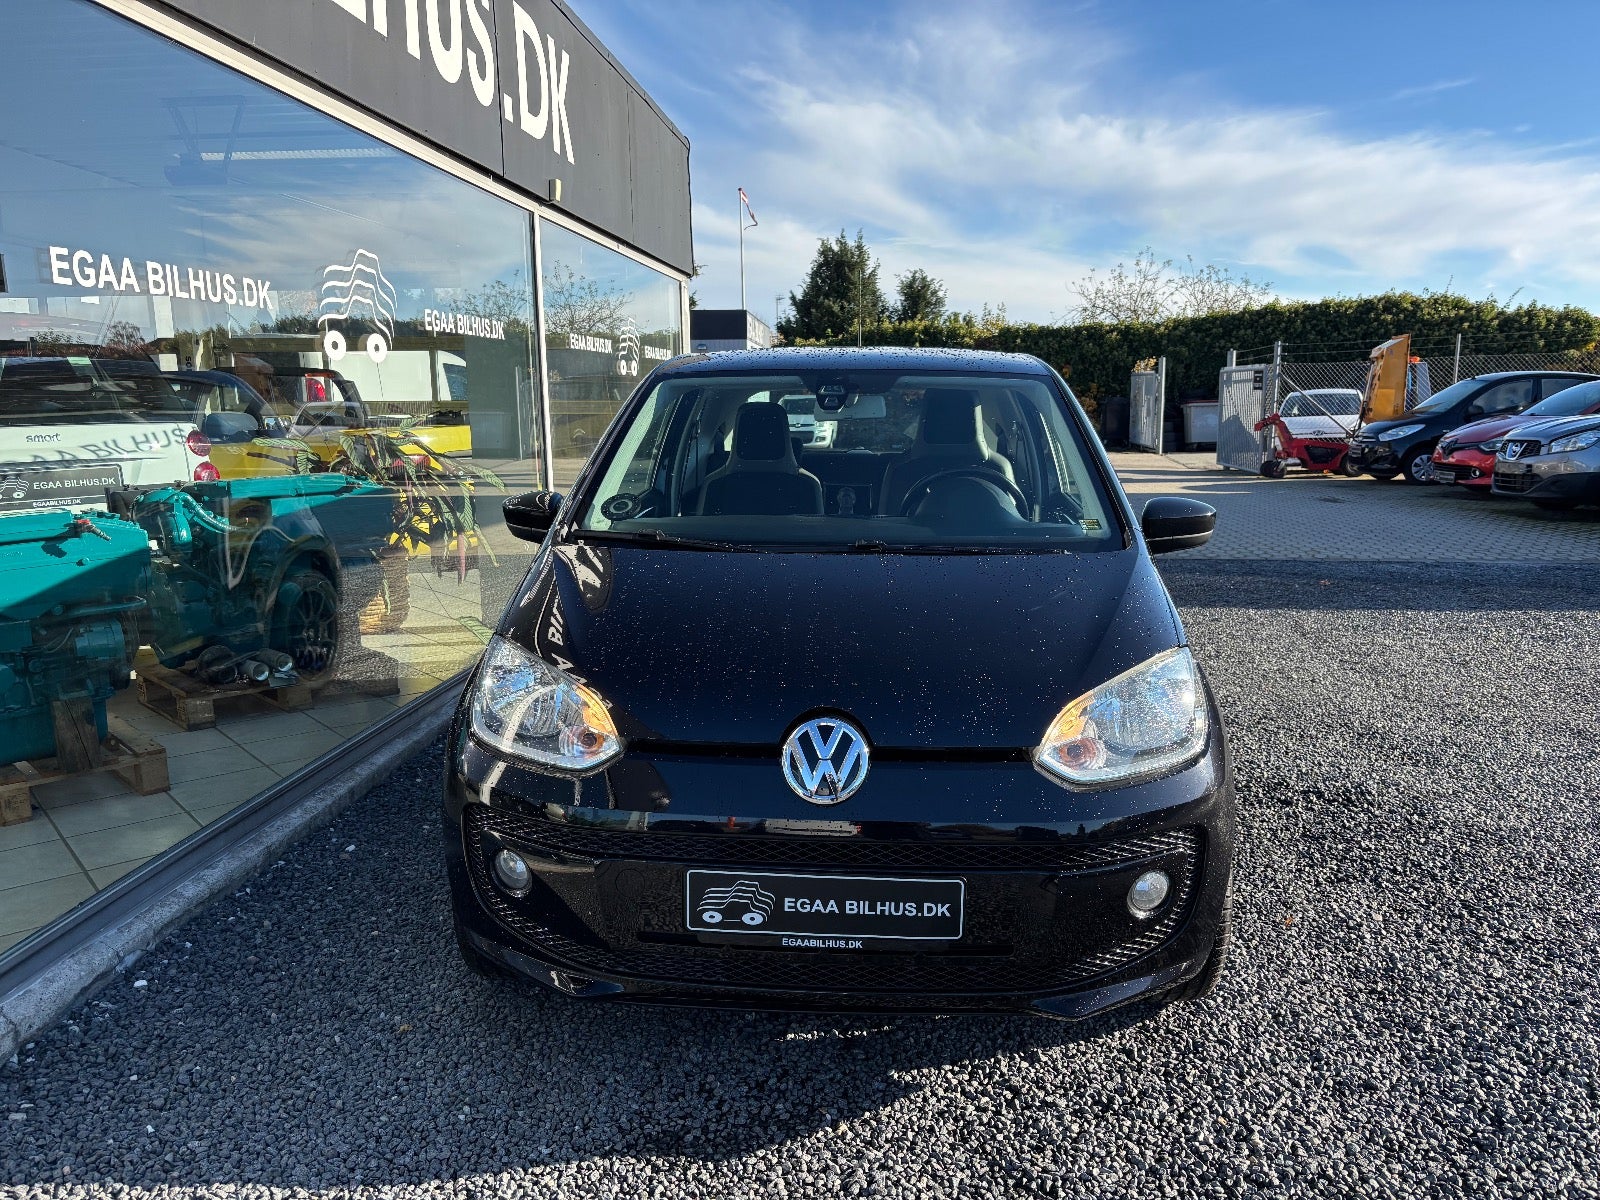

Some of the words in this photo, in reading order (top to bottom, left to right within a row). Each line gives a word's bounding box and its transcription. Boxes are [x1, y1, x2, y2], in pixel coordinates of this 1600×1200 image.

[331, 0, 575, 165] US.DK
[49, 245, 140, 292] EGAA
[146, 260, 274, 310] BILHUS.DK
[424, 308, 455, 334] EGAA
[456, 313, 505, 341] BILHUS.DK
[26, 432, 61, 443] smart
[33, 479, 62, 490] EGAA
[64, 477, 116, 488] BILHUS.DK
[783, 897, 839, 914] EGAA
[845, 900, 951, 918] BILHUS.DK
[782, 937, 863, 949] EGAABILHUS.DK
